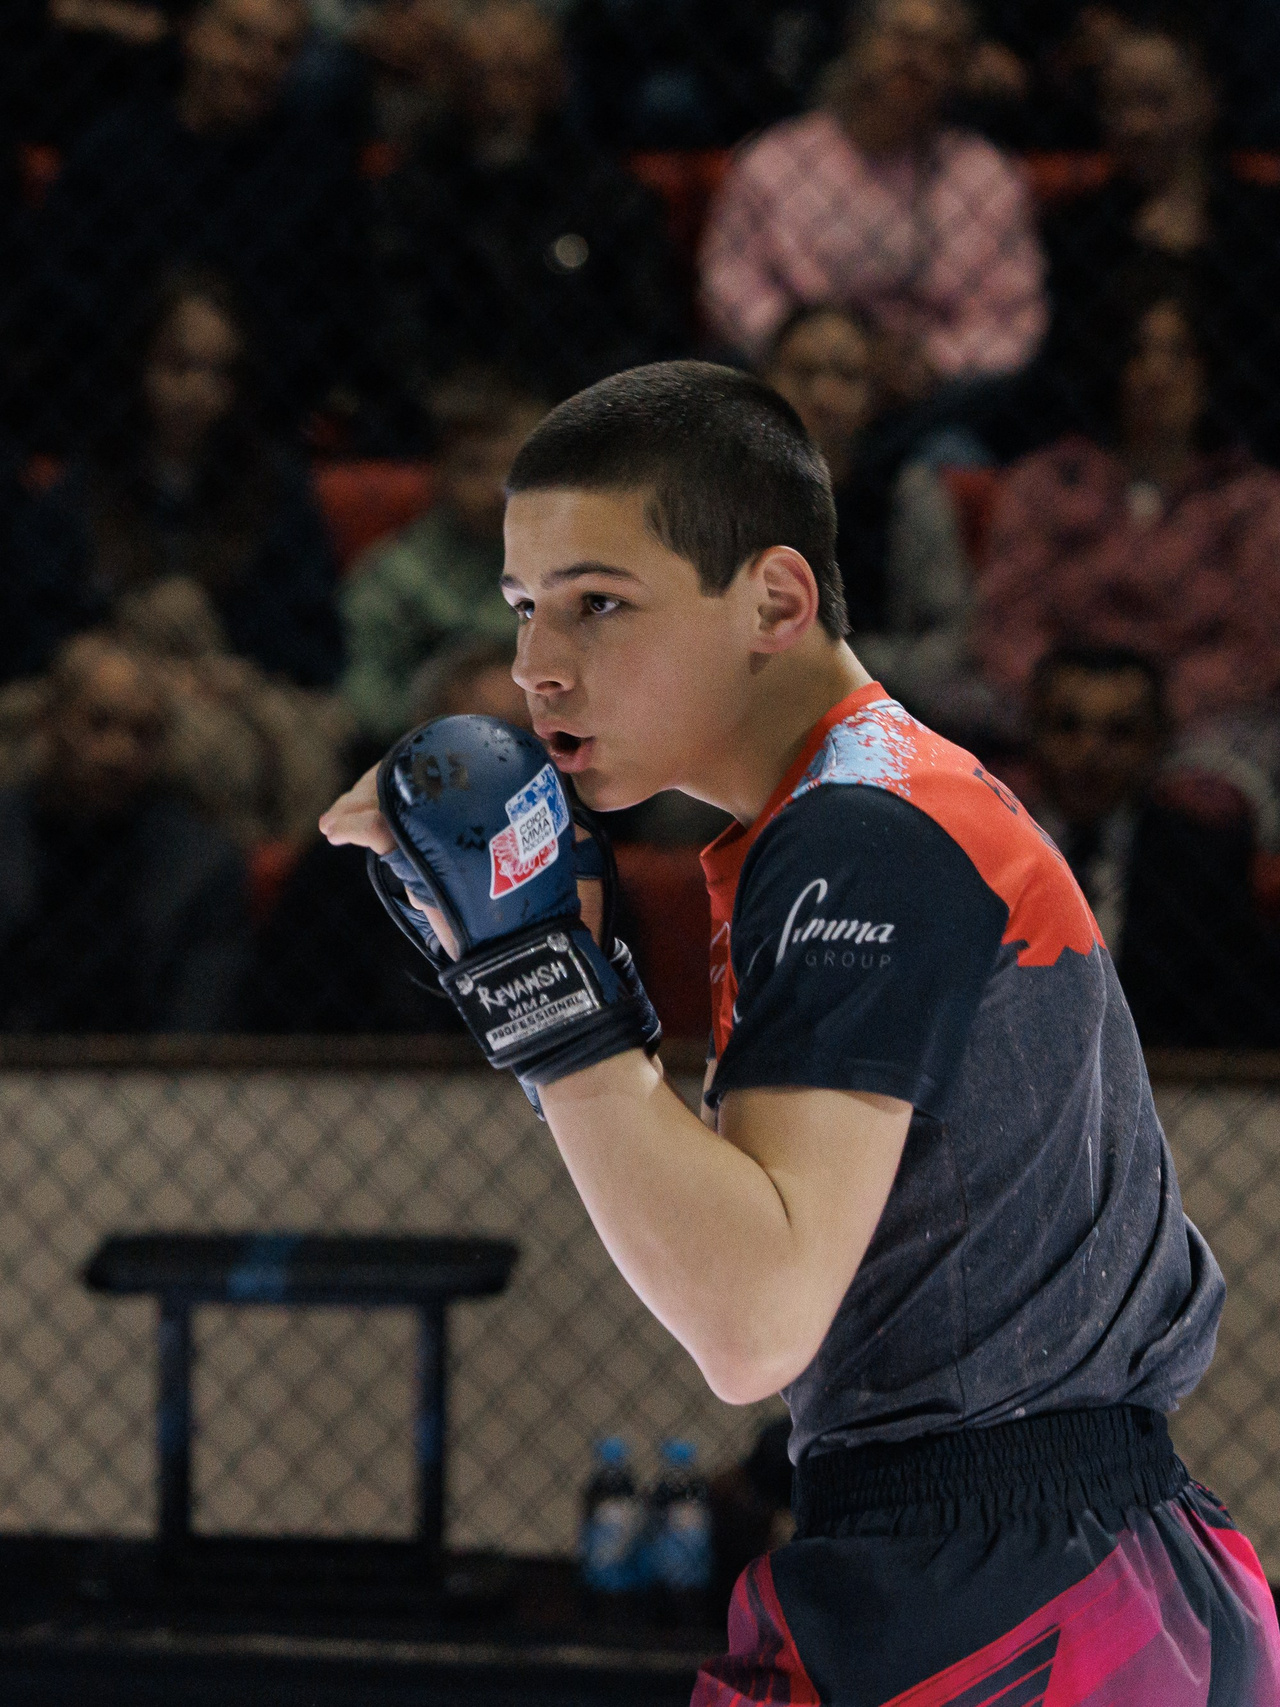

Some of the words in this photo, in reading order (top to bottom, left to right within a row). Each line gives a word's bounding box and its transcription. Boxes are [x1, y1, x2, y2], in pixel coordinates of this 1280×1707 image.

[519, 806, 548, 835] СОЮЗ
[521, 819, 550, 846] ММА
[805, 950, 891, 969] GROUP
[491, 994, 584, 1042] PROFESSIONAL
[507, 993, 551, 1021] MMA
